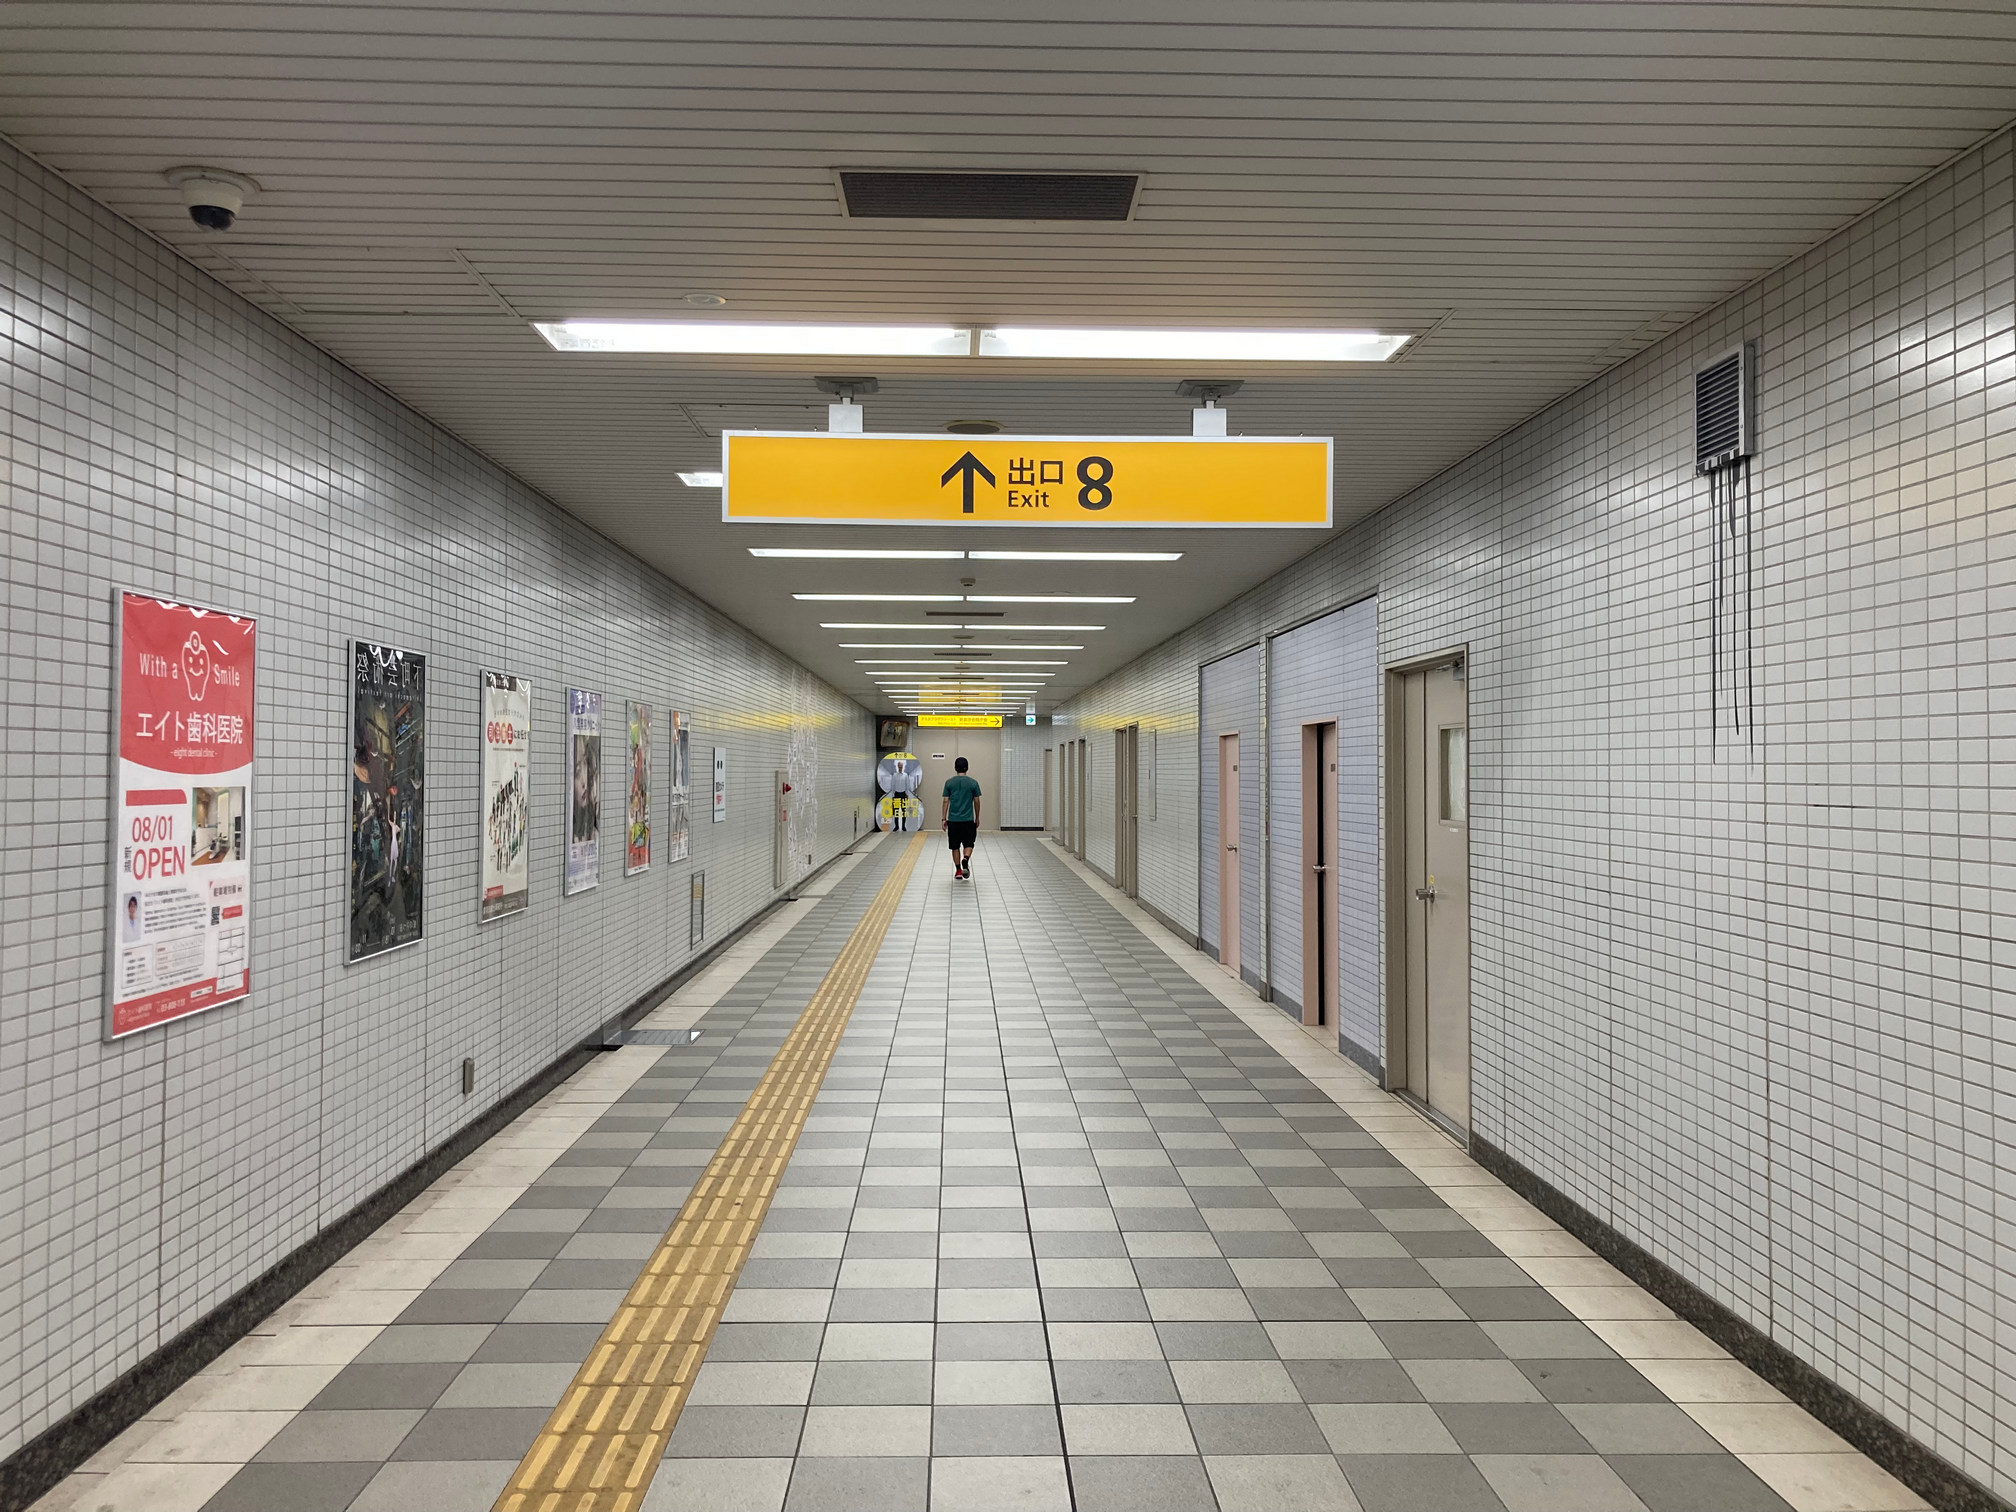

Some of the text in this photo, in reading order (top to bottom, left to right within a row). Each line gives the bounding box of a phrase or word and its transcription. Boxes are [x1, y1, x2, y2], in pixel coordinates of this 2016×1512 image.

[1008, 456, 1114, 511] 出口 8
[1008, 490, 1050, 508] Exit
[140, 653, 240, 687] With a Smile
[136, 711, 243, 745] エイト歯科医院
[132, 815, 173, 843] 08/01
[133, 845, 185, 881] OPEN
